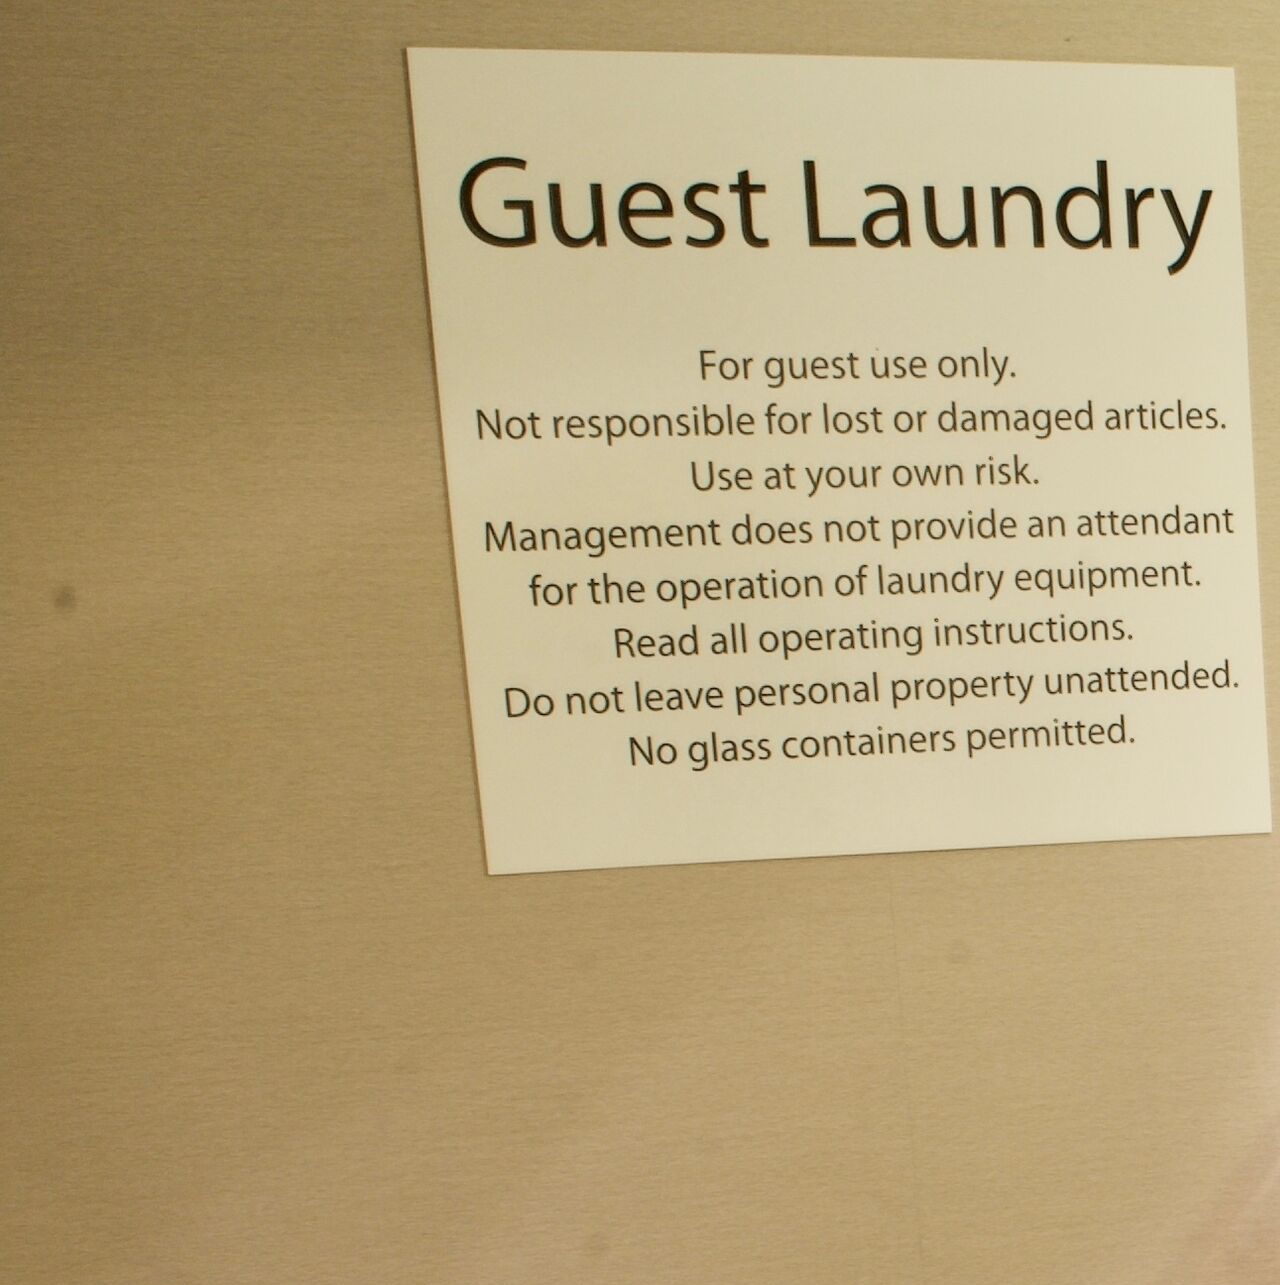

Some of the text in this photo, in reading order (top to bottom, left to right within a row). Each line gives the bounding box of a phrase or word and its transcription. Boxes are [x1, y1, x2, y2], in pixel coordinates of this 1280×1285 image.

[458, 156, 1214, 277] Guest Laundry
[699, 346, 1016, 389] For guest use only.
[475, 398, 1227, 447] Not responsible for lost or damaged articles.
[690, 453, 1040, 498] Use at your own risk.
[485, 504, 1235, 559] Management does not provide an attendant
[528, 560, 1201, 610] for the operation of laundry equipment.
[614, 613, 1133, 661] Read all operating instructions.
[504, 658, 1239, 718] Do not leave personal property unattended.
[628, 713, 1135, 772] No glass containers permitted.
